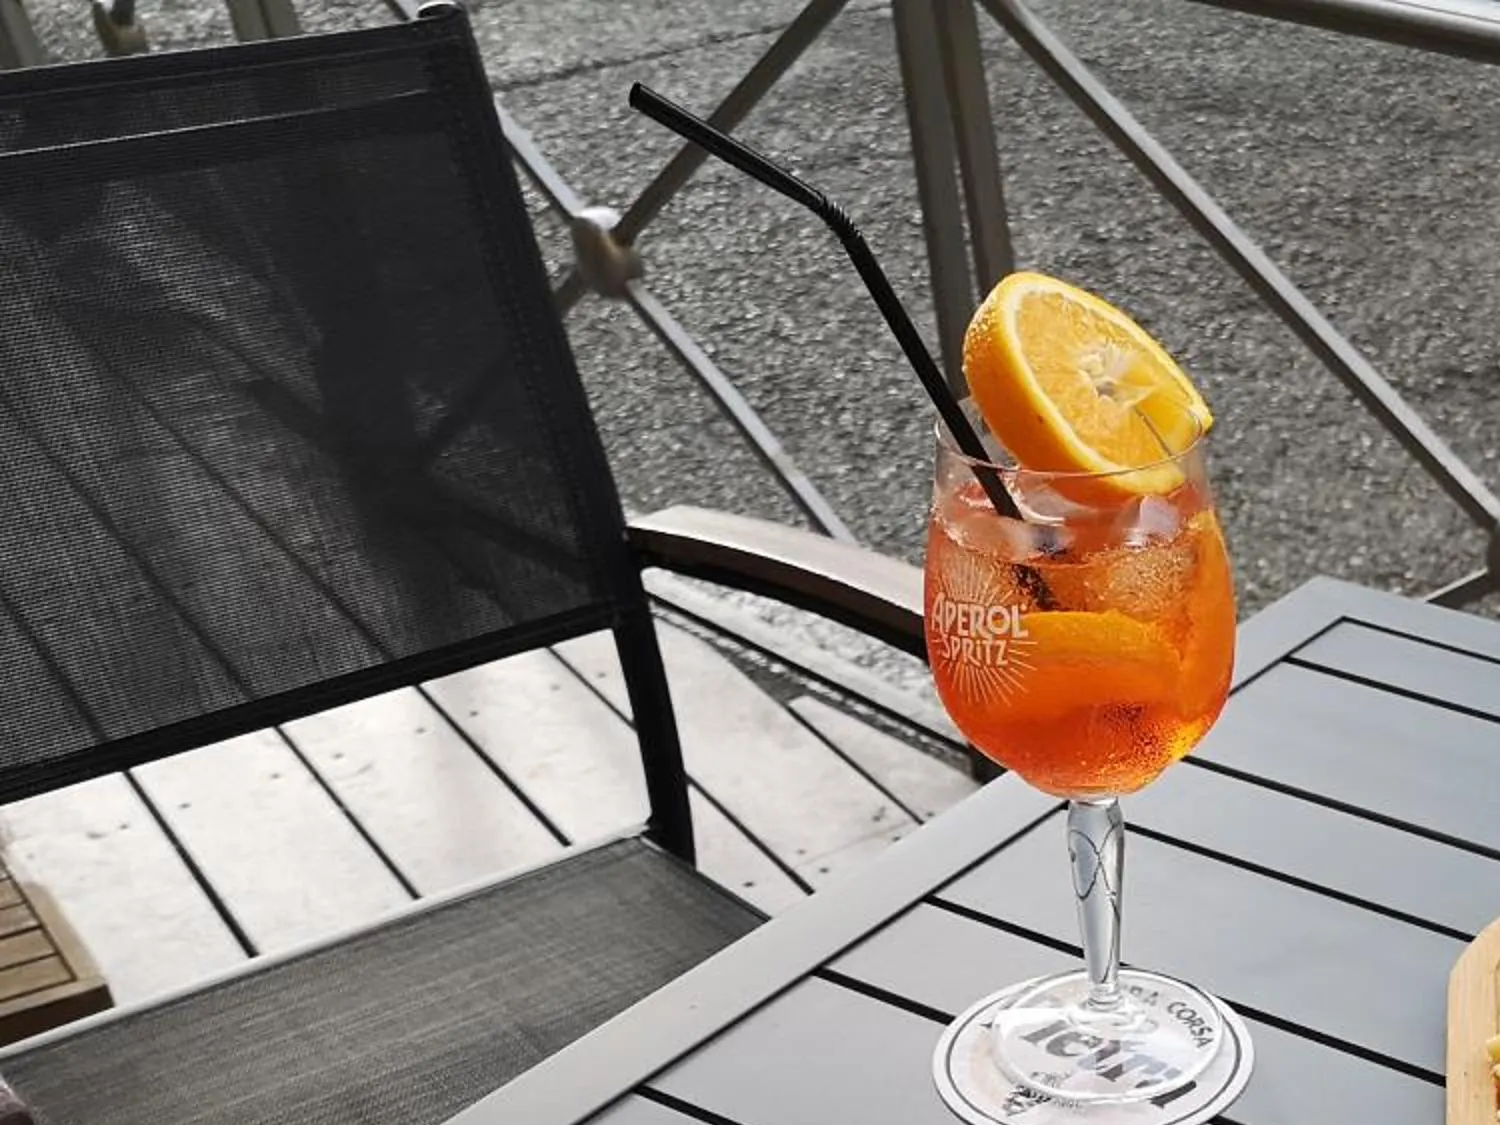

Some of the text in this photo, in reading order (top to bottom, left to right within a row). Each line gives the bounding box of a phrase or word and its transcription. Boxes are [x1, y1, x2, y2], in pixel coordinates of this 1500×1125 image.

[931, 591, 1029, 640] APEROL
[940, 633, 1009, 666] SPRITZ
[1166, 1001, 1215, 1048] CORSA
